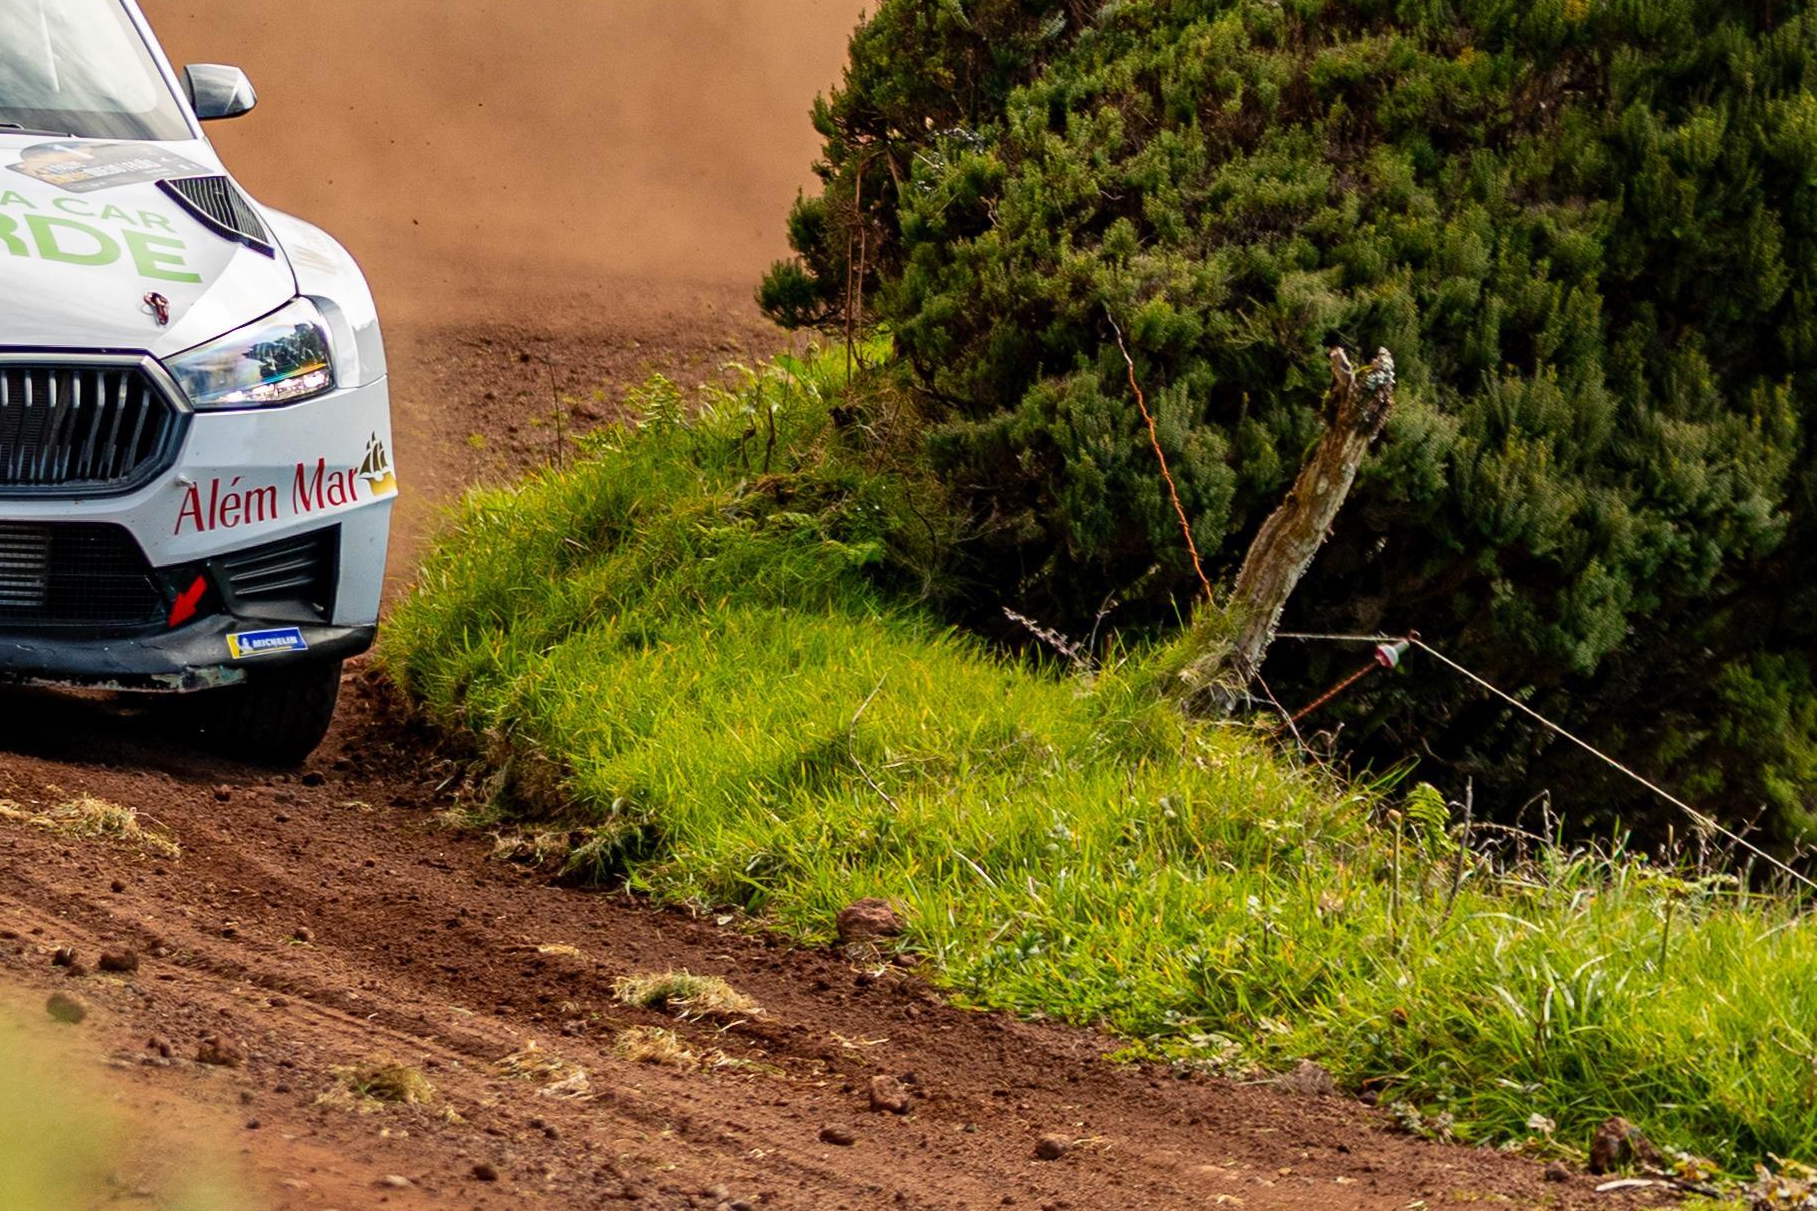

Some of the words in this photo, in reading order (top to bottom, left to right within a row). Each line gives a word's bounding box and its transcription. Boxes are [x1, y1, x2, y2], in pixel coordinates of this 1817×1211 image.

[0, 189, 33, 208] A
[52, 197, 172, 232] CAR
[174, 475, 277, 536] Além
[292, 457, 360, 515] Mar
[251, 636, 299, 649] MICHELIN
